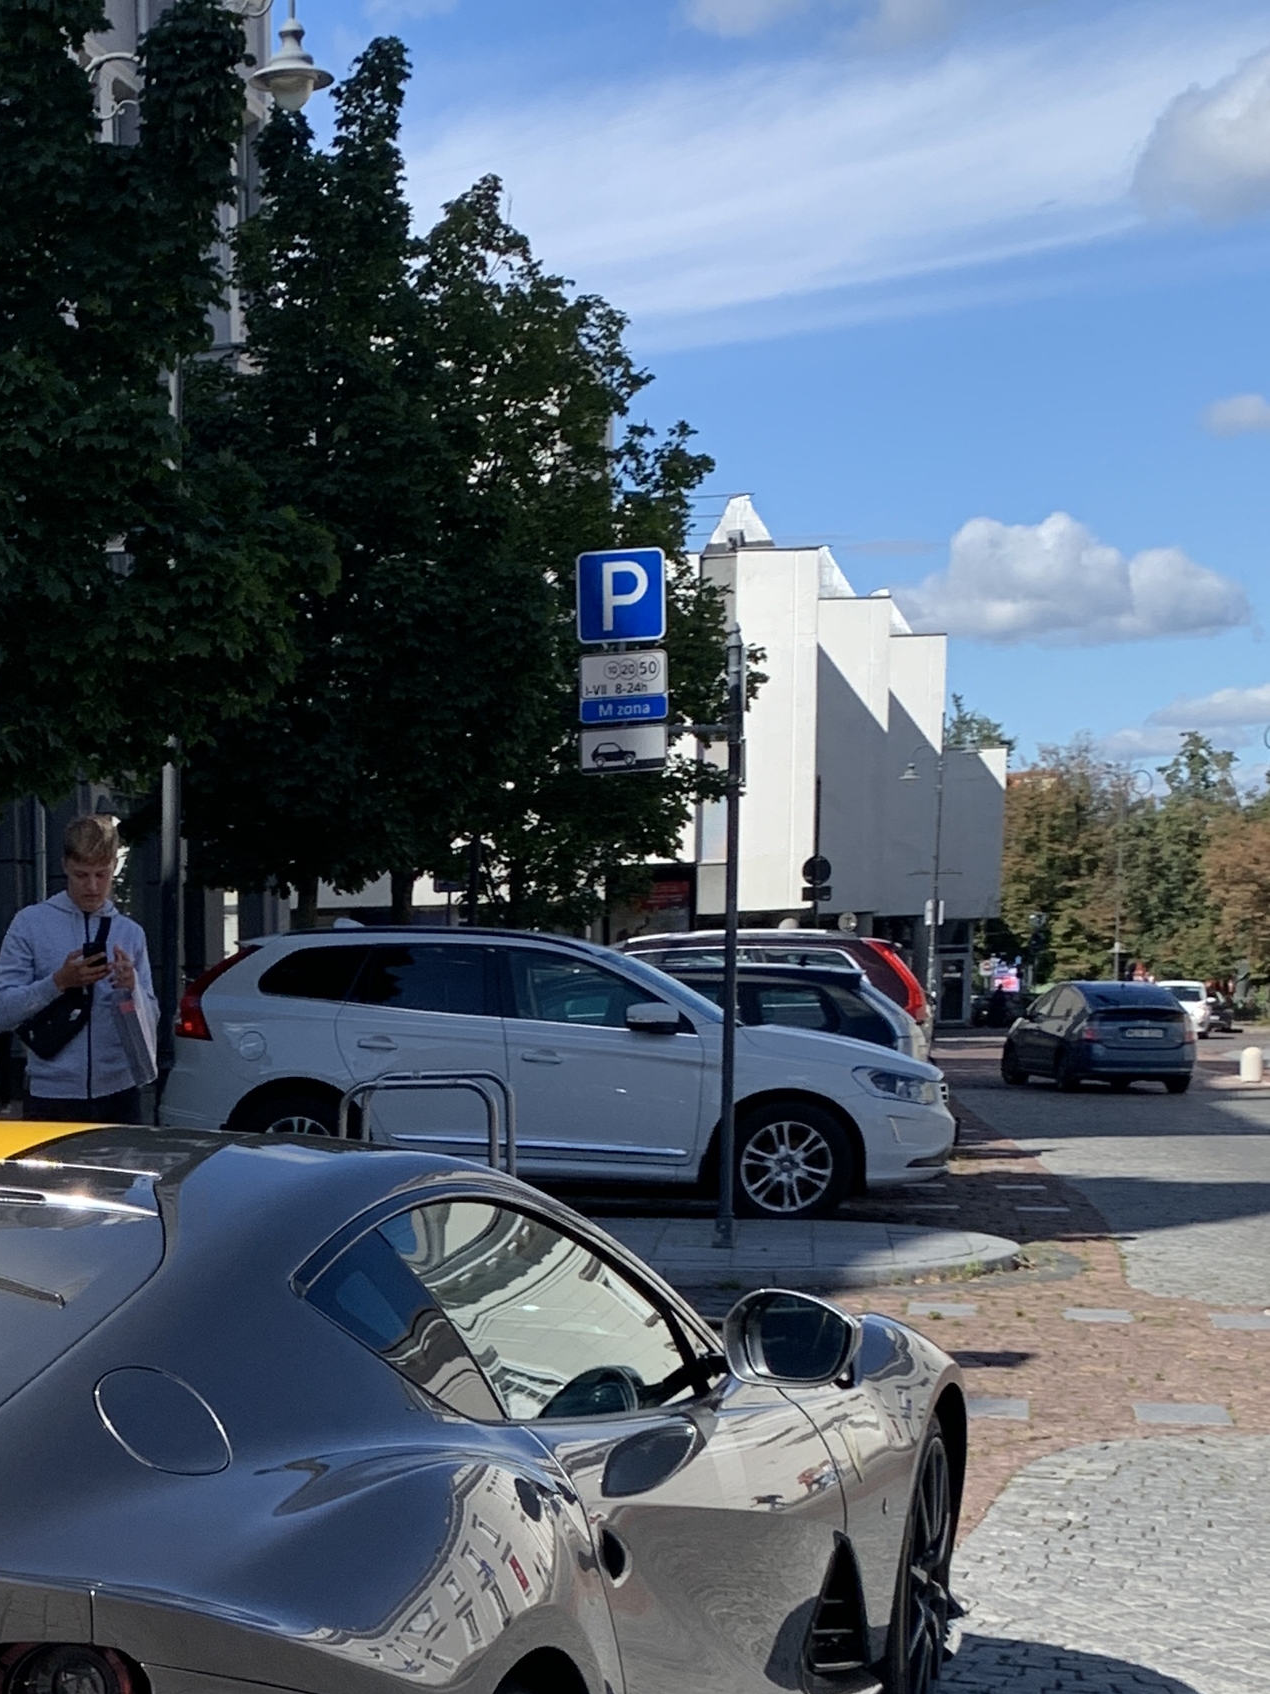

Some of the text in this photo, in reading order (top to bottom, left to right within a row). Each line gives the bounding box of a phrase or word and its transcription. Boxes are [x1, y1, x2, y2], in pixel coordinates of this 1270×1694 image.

[601, 560, 649, 632] P
[639, 661, 657, 675] 50
[598, 703, 651, 717] M zona
